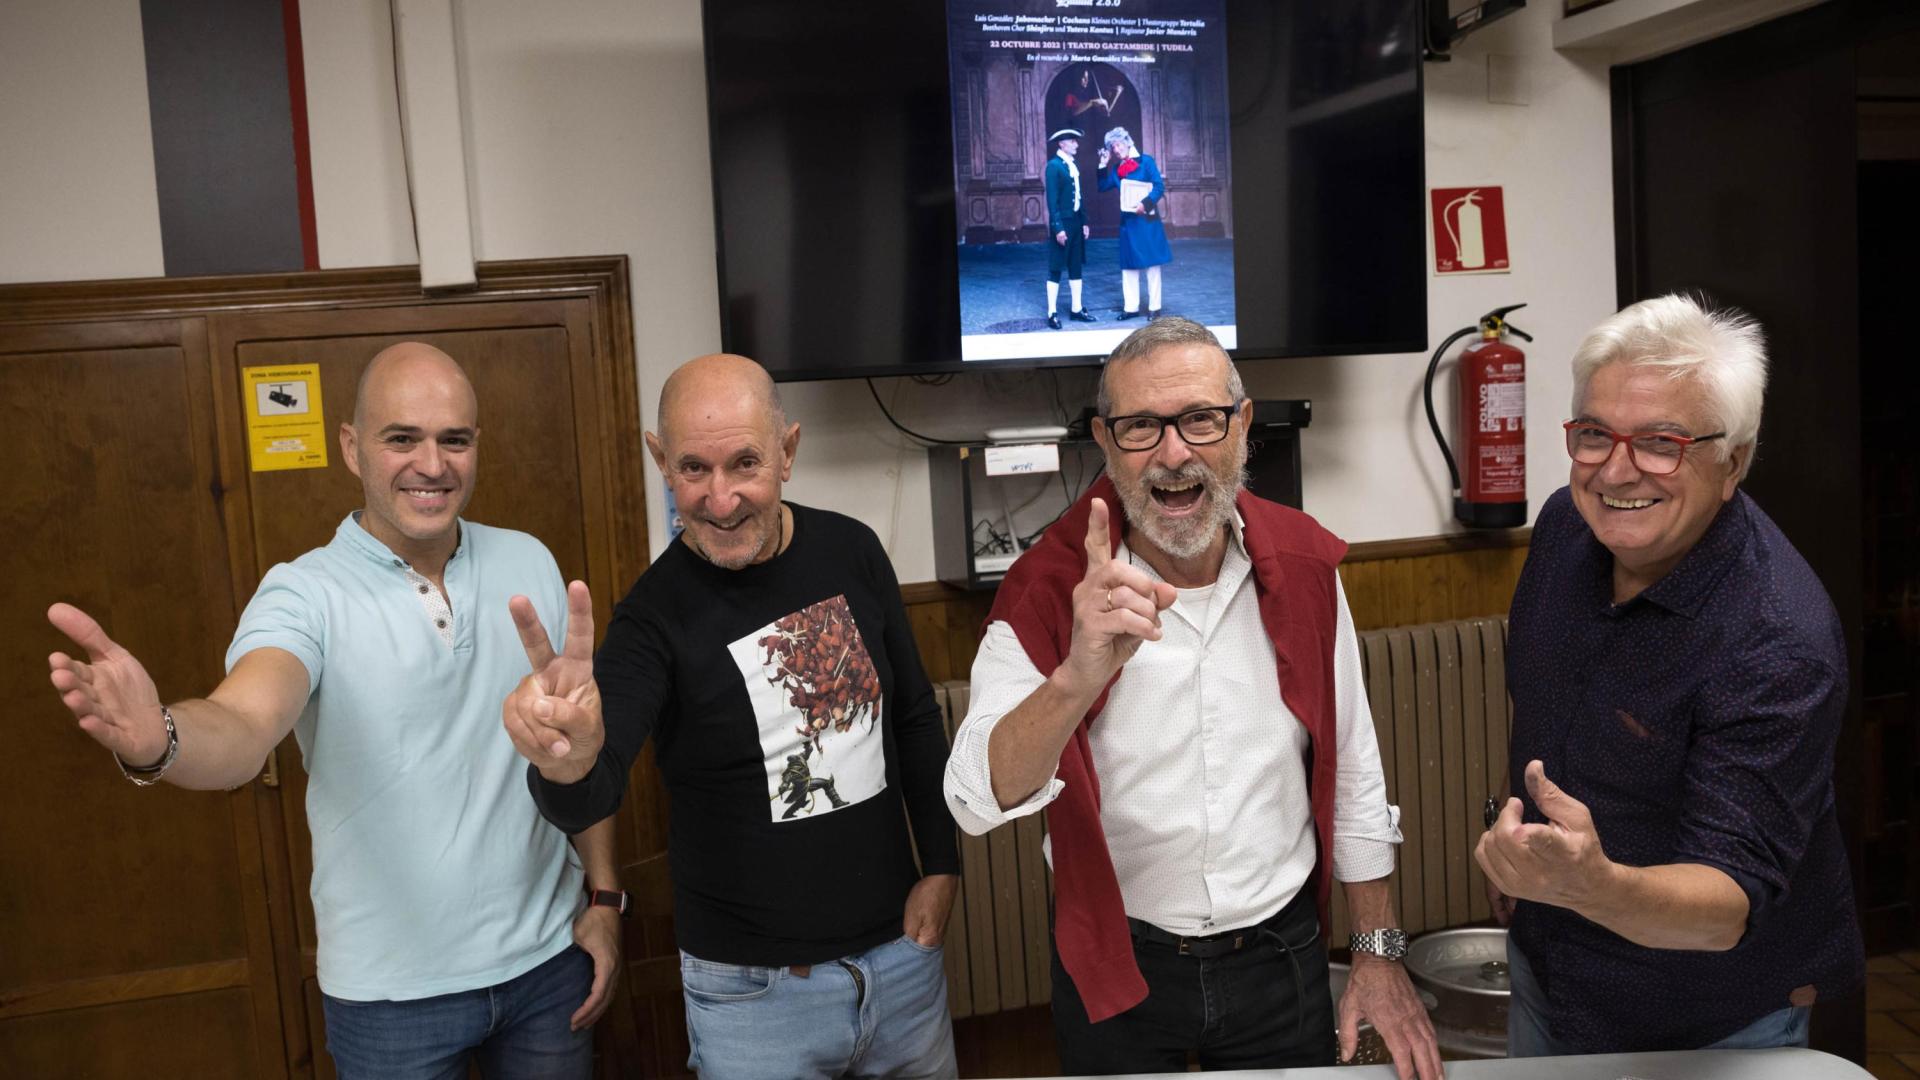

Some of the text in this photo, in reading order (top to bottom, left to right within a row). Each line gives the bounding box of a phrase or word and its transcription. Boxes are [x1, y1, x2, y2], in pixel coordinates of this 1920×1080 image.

[974, 14, 987, 22] Luis
[1180, 19, 1206, 28] Tertulia
[1011, 24, 1026, 32] Chor
[1145, 27, 1166, 37] Javier
[989, 40, 1000, 49] 22
[1001, 40, 1041, 49] OCTUBRE
[1042, 41, 1061, 49] 2022
[1067, 42, 1101, 50] TEATRO
[1102, 42, 1155, 51] GAZTAMBIDE
[1161, 43, 1194, 52] TUDELA
[1026, 53, 1035, 61] En
[1479, 383, 1488, 432] POLVO
